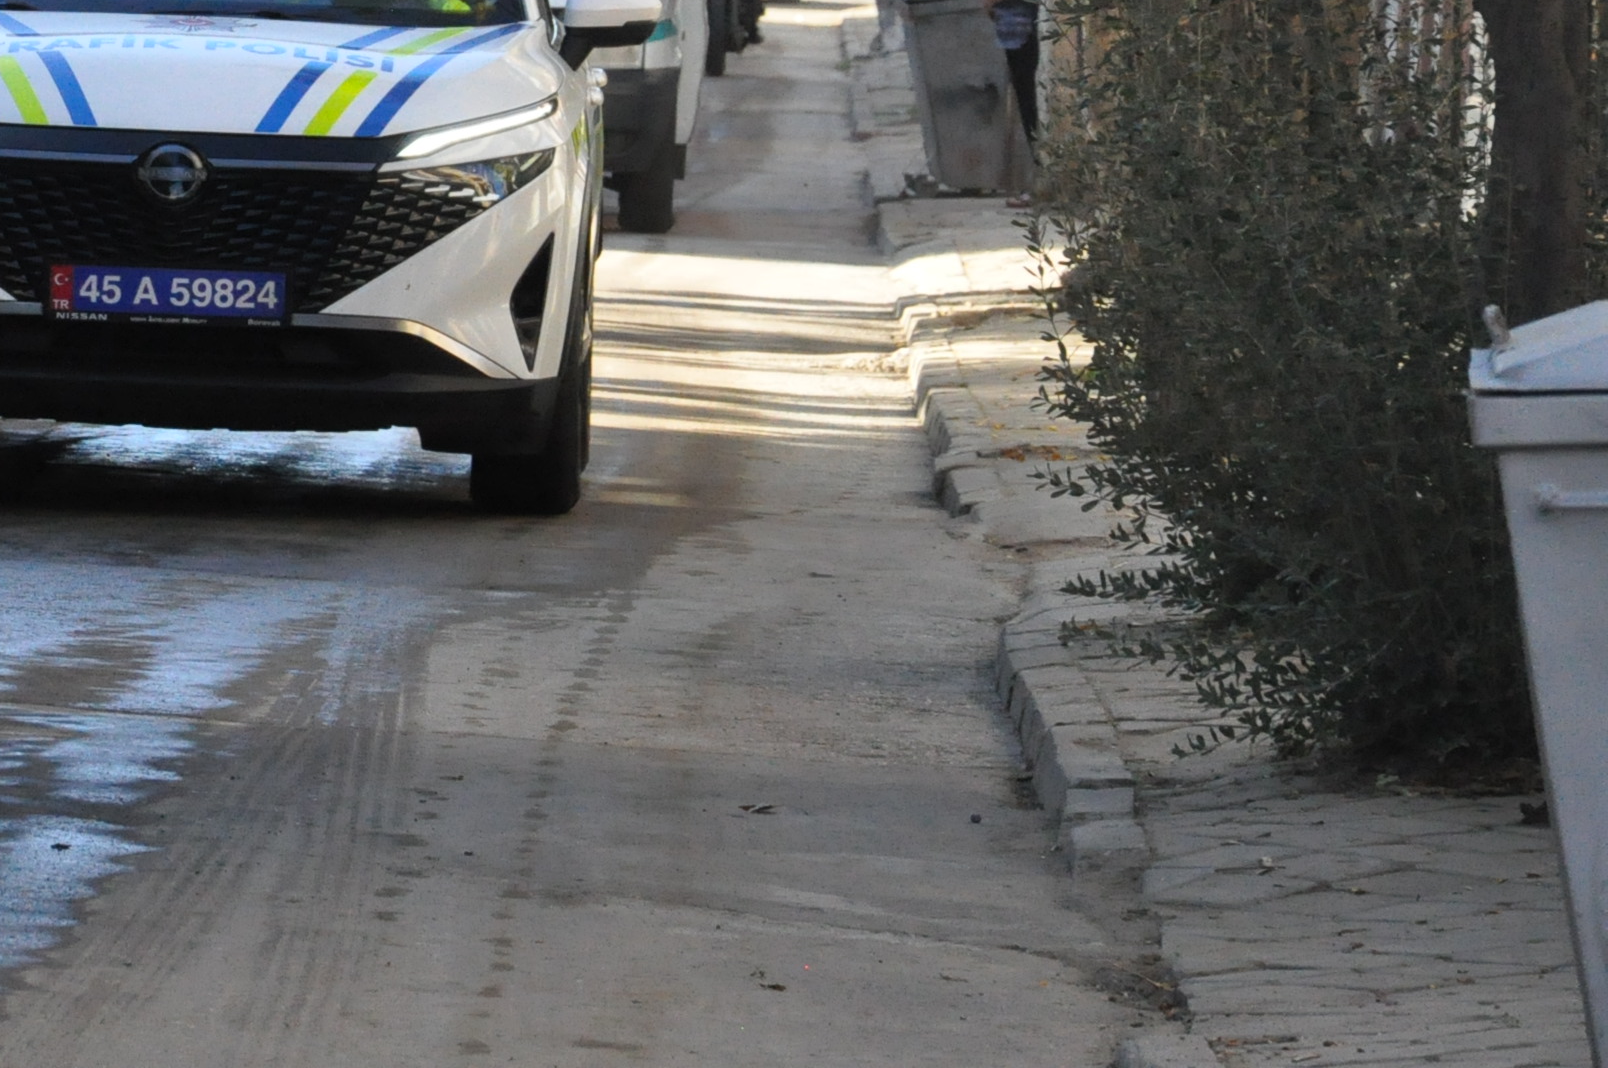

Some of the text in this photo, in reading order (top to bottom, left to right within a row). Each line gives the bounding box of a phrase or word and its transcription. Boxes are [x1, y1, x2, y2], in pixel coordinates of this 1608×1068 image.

[78, 274, 279, 310] 45 A 59824
[52, 299, 70, 311] TR
[56, 311, 108, 322] NISSAN
